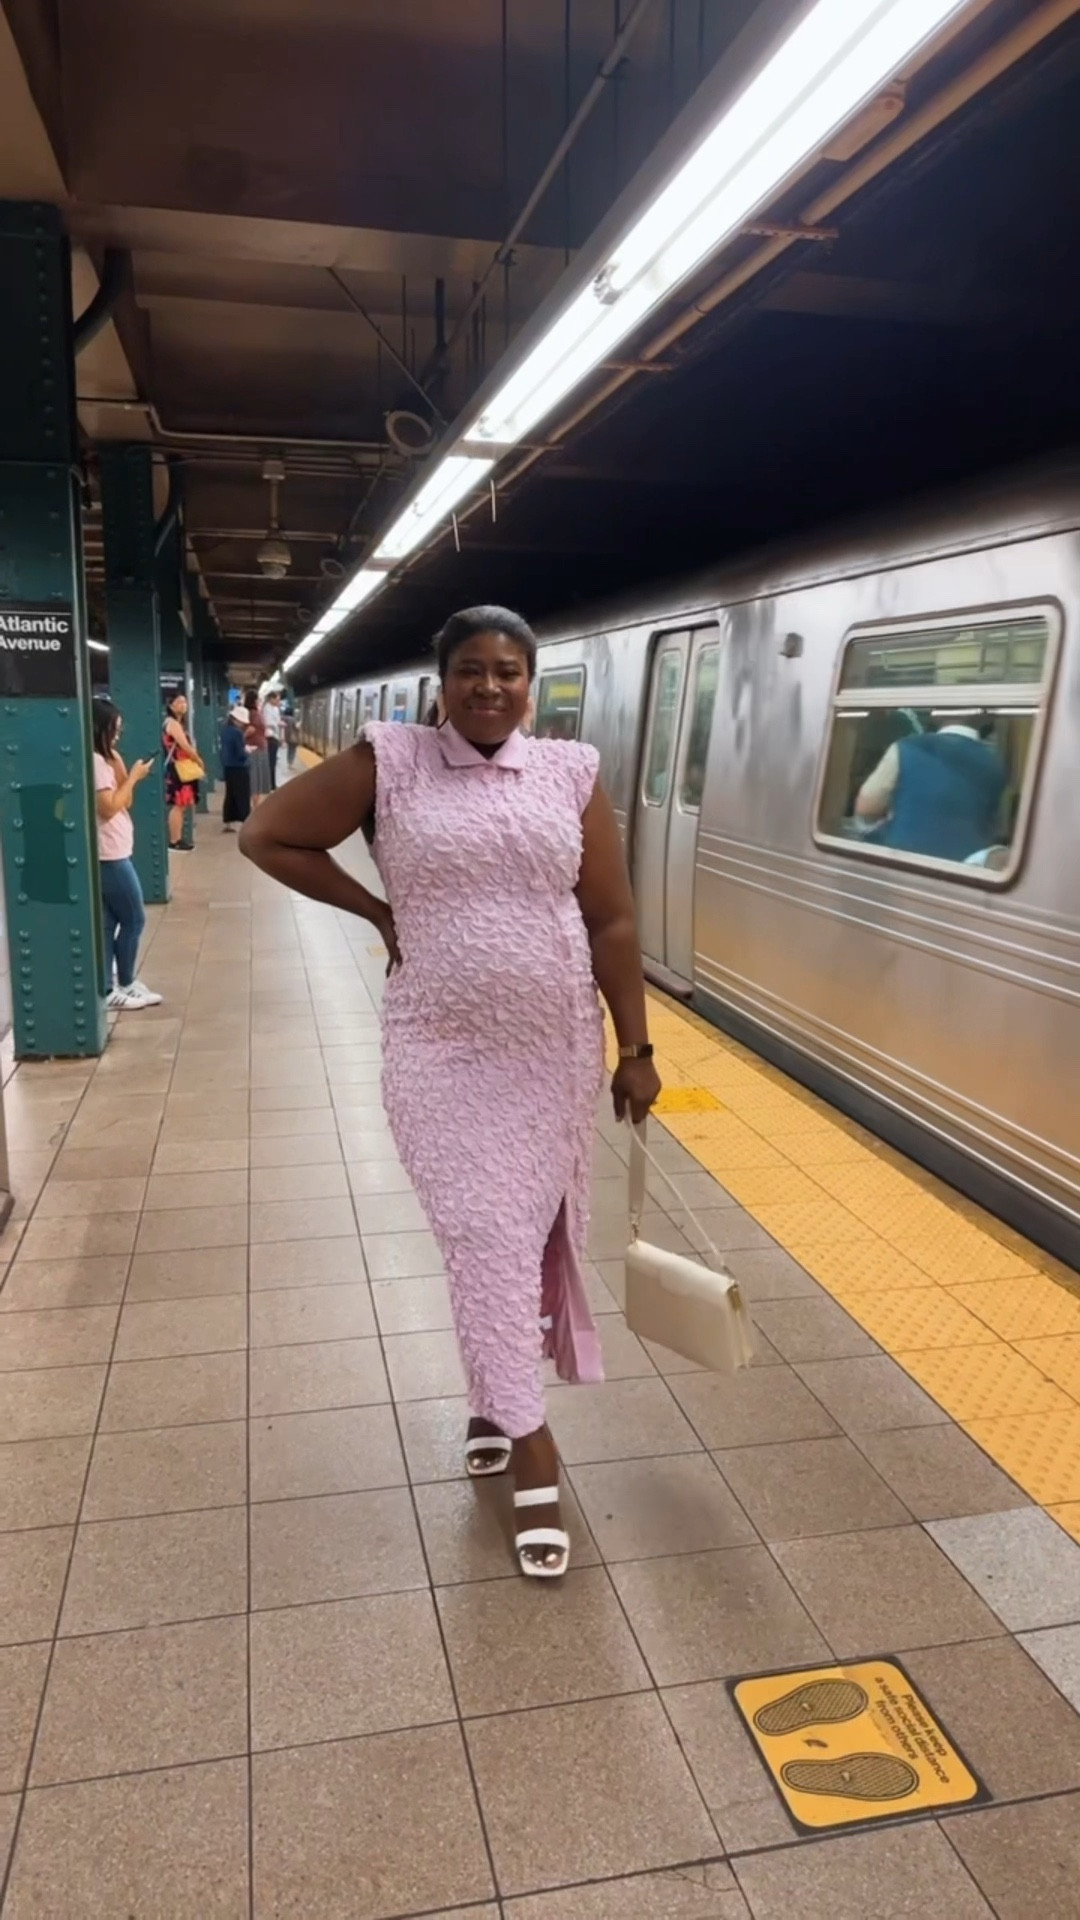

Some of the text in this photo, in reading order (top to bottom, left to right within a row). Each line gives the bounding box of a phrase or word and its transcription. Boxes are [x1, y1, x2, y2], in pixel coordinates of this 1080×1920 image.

[0, 615, 69, 633] Atlantic
[0, 635, 61, 651] Avenue
[876, 1700, 918, 1759] from others
[879, 1684, 898, 1706] safe
[895, 1706, 921, 1736] social
[914, 1737, 950, 1783] distance
[901, 1694, 947, 1756] Please keep
